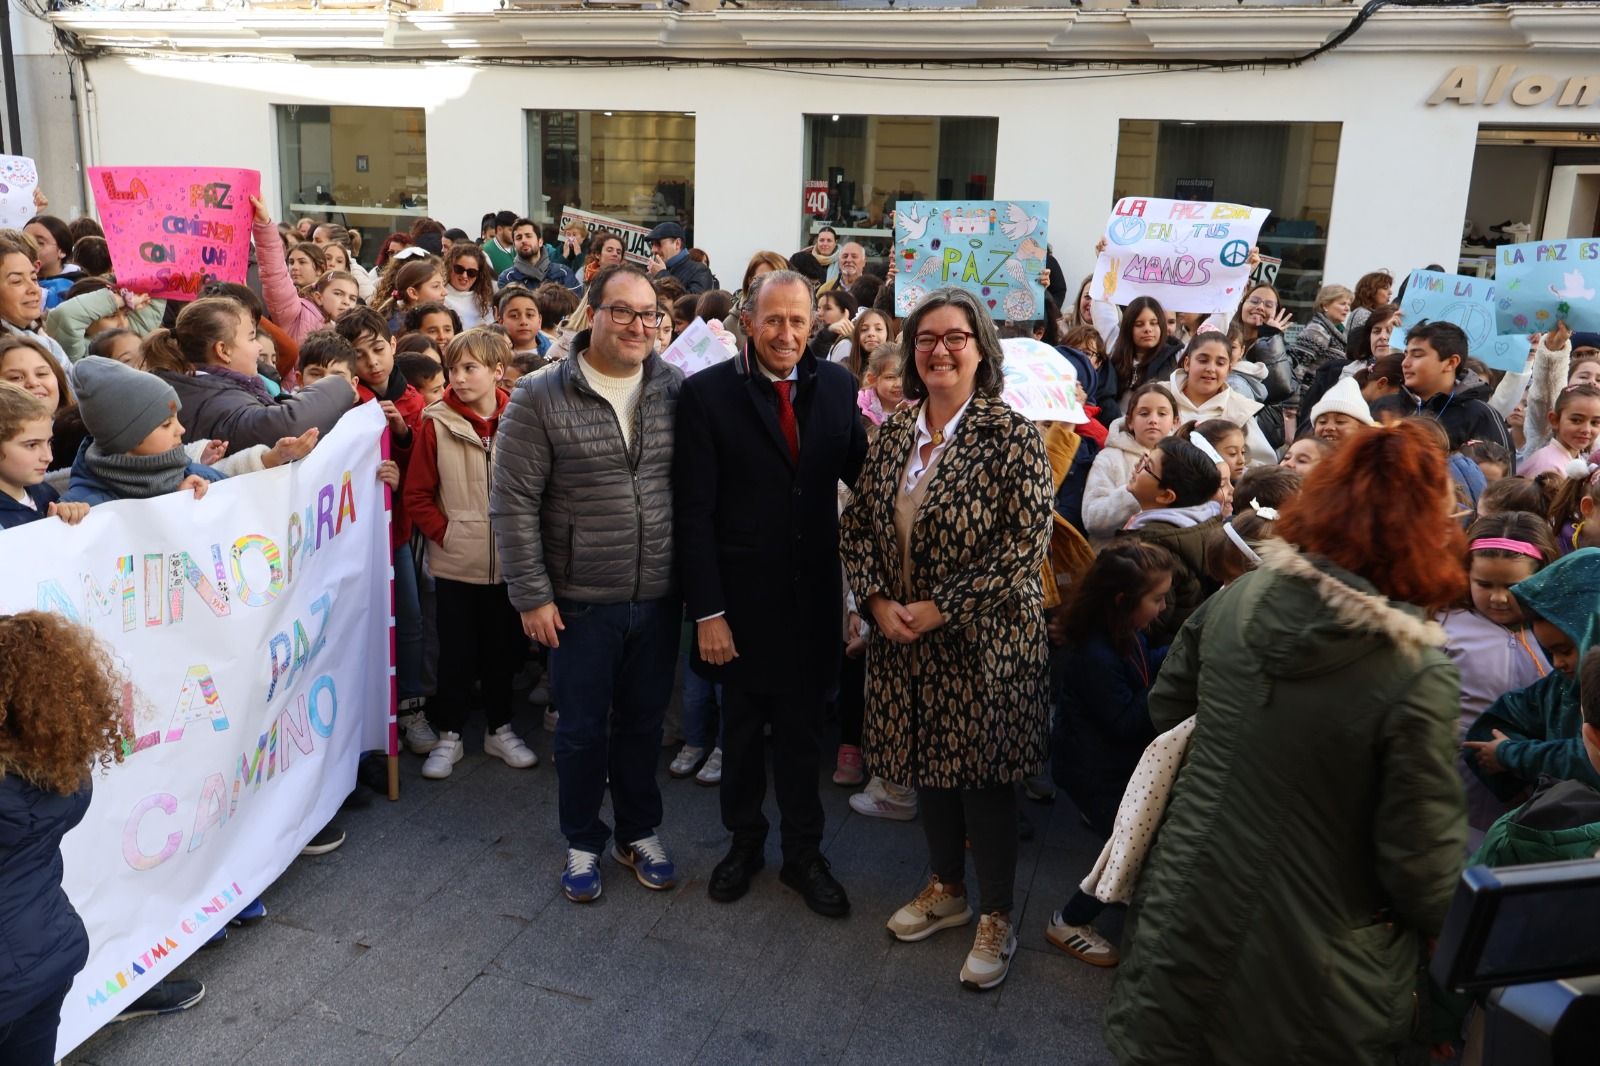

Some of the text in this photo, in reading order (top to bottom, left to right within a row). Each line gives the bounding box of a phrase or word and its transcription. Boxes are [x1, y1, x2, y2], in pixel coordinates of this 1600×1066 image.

[102, 171, 233, 210] LA PAZ
[1114, 199, 1148, 218] LA
[1169, 202, 1208, 220] PAZ
[1145, 222, 1231, 240] EN TUS
[138, 241, 228, 266] CON UNA
[941, 247, 1015, 288] PAZ
[1122, 254, 1215, 287] MANOS
[1504, 248, 1525, 266] LA
[1536, 243, 1568, 262] PAZ
[1453, 281, 1473, 298] LA
[286, 469, 357, 585] PARA
[120, 590, 333, 758] LA PAZ
[121, 674, 338, 872] CAMINO
[86, 880, 243, 1013] MAHATMA GANDHI
